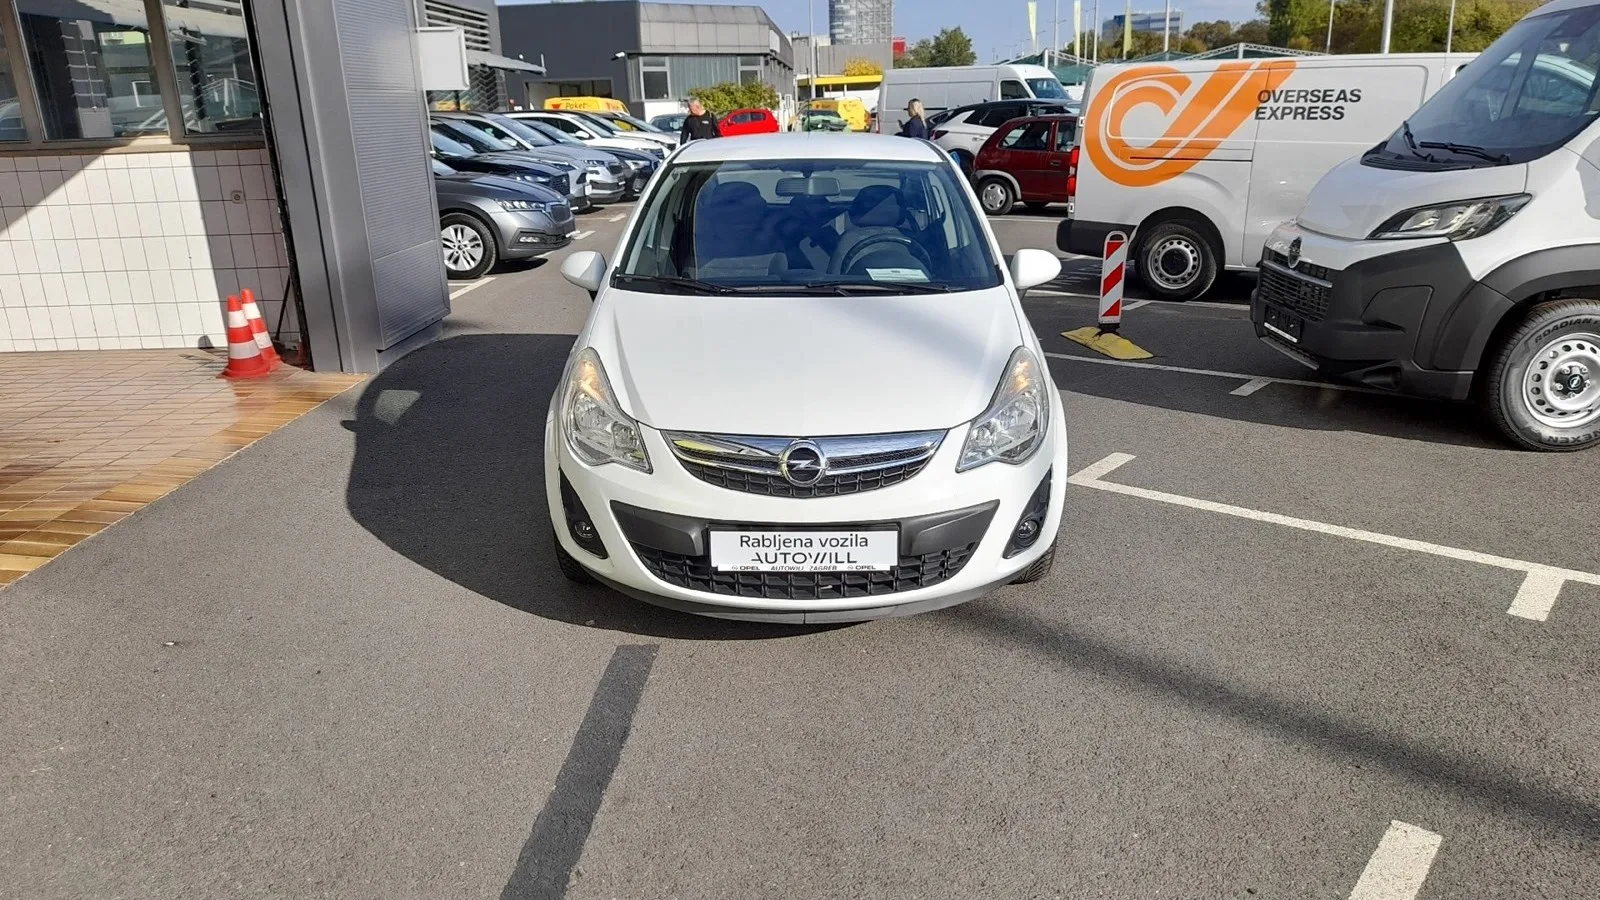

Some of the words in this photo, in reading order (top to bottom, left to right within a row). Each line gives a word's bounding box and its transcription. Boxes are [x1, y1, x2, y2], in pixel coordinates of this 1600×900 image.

[1257, 88, 1362, 103] OVERSEAS
[1254, 105, 1345, 120] EXPRESS
[1535, 318, 1592, 343] ROADIAN
[740, 534, 813, 550] Rabljena
[819, 533, 869, 548] vozila
[751, 552, 857, 564] AUTOWILL
